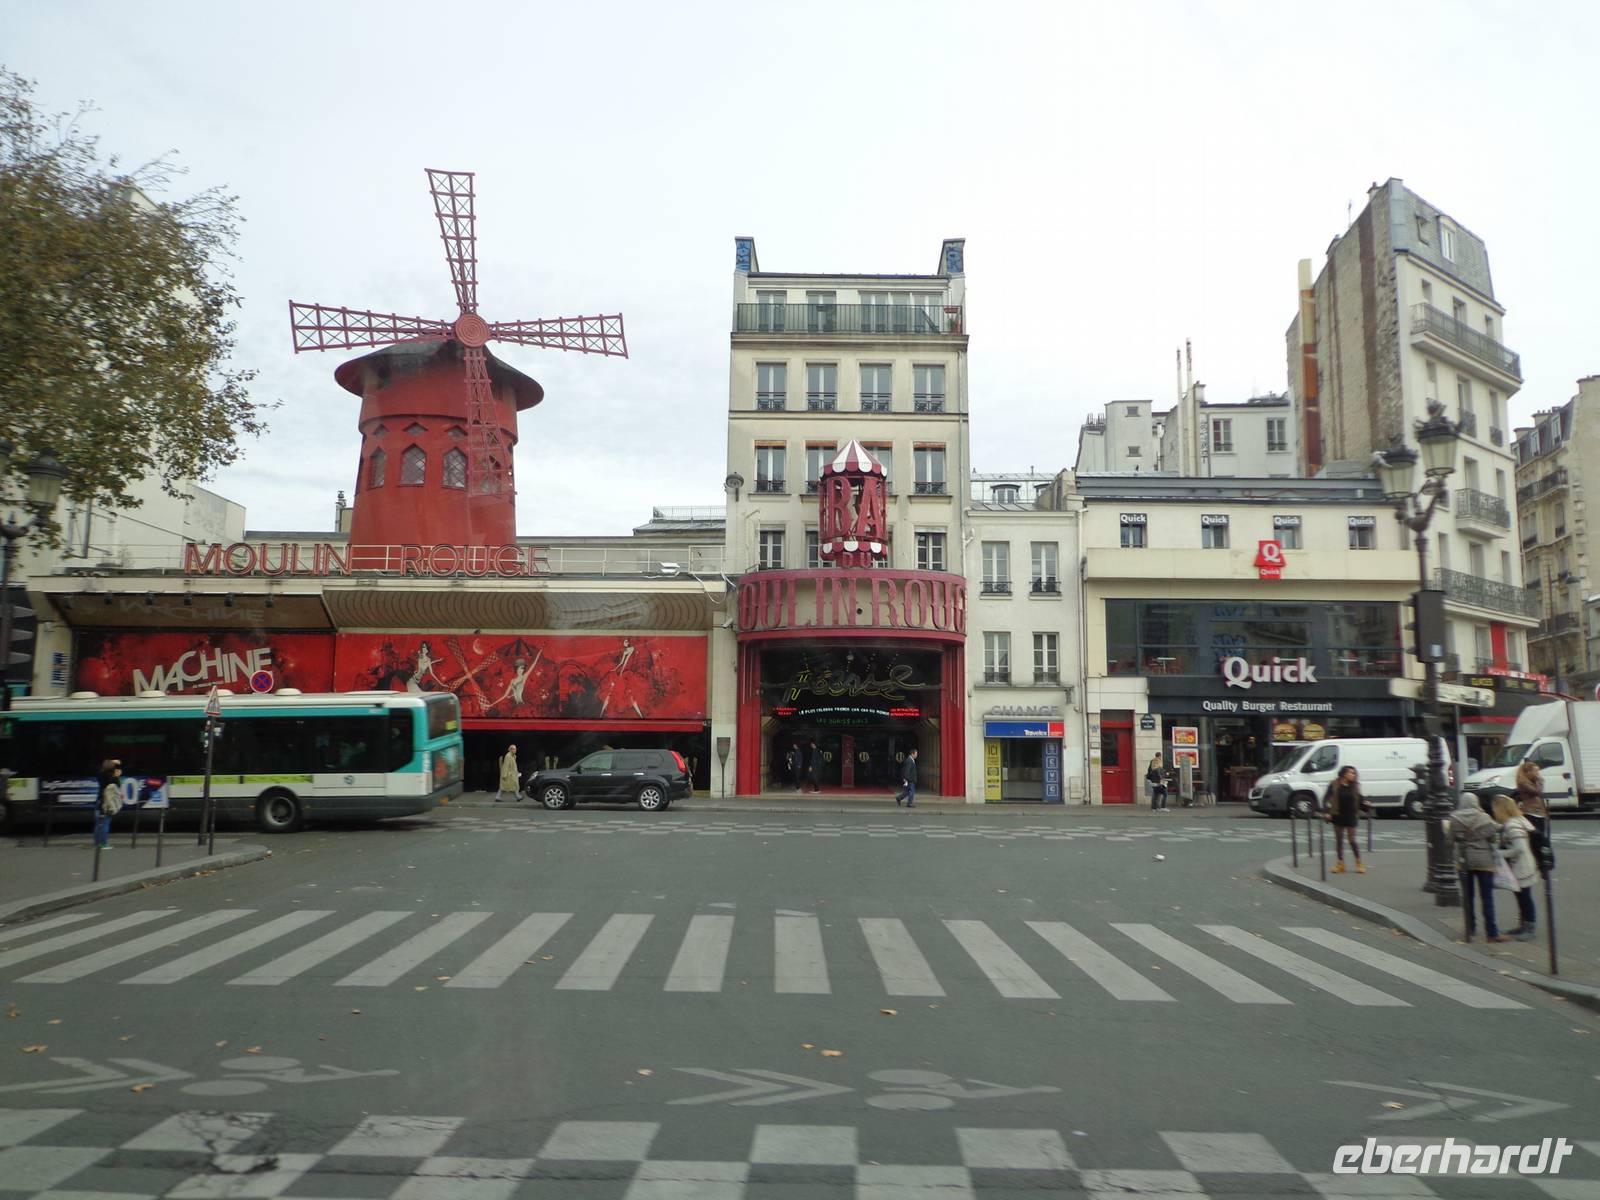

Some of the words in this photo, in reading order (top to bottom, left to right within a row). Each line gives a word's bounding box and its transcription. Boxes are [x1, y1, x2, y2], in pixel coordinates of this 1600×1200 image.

[1120, 514, 1147, 524] Quick
[1202, 515, 1228, 525] Quick
[1274, 516, 1300, 526] Quick
[1349, 516, 1375, 526] Quick
[1262, 543, 1281, 563] Q
[183, 543, 352, 577] MOULIN
[400, 543, 550, 577] ROUGE
[1260, 567, 1281, 576] Quick
[739, 577, 858, 632] OULIN
[871, 577, 967, 633] ROUG
[132, 647, 273, 698] MACHINE
[1223, 656, 1318, 689] Quick
[991, 705, 1059, 716] CHANGE
[1202, 700, 1238, 712] Quality
[1242, 701, 1276, 712] Burger
[1280, 701, 1333, 711] Restaurant
